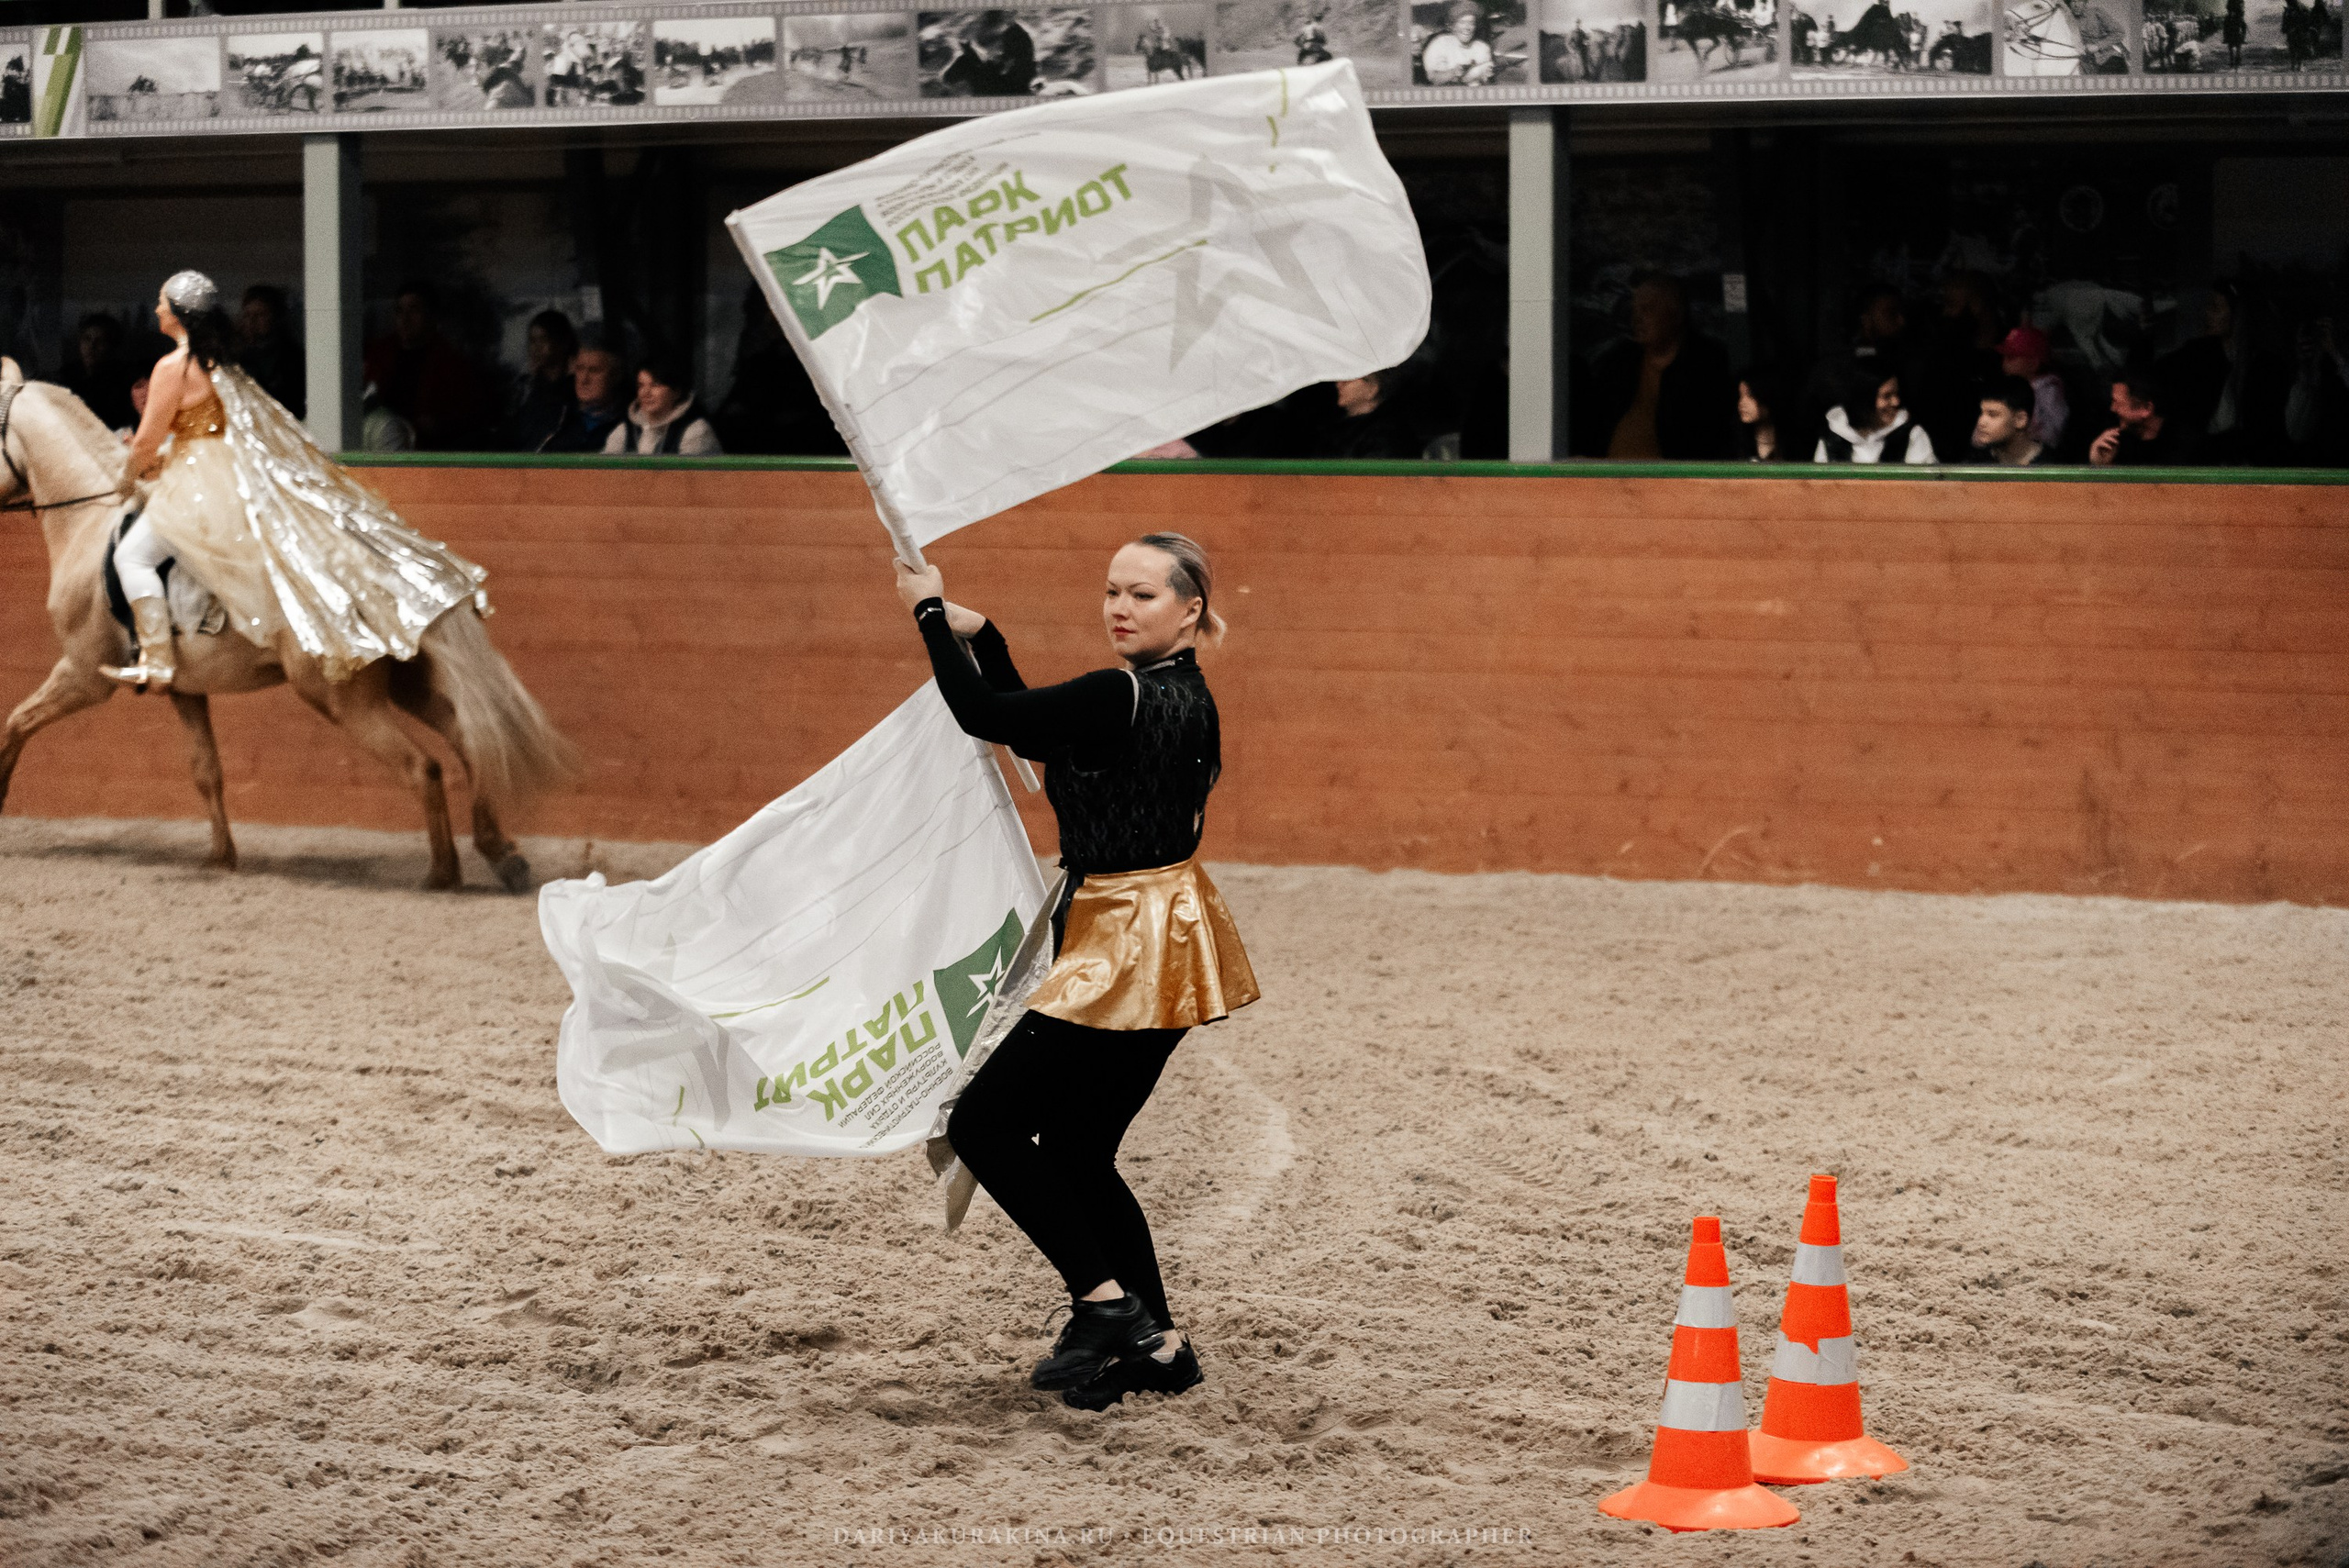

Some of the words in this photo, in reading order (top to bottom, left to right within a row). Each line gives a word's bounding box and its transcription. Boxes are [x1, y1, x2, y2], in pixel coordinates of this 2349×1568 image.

[896, 169, 1041, 263] ПАРК
[915, 163, 1132, 294] ПАТРИОТ
[753, 979, 925, 1112] ПАТРИТ
[806, 1010, 937, 1122] ПАРК
[885, 1041, 941, 1089] РОССИЙСКОЙ
[880, 1050, 944, 1106] ВООРУЖЕННЫХ
[897, 1095, 907, 1105] И
[905, 1058, 948, 1099] КУЛЬТУРЫ
[838, 1085, 885, 1129] ФЕДЕРАЦИИ
[863, 1104, 882, 1121] СИЛ
[869, 1103, 899, 1129] ОТДЫХА
